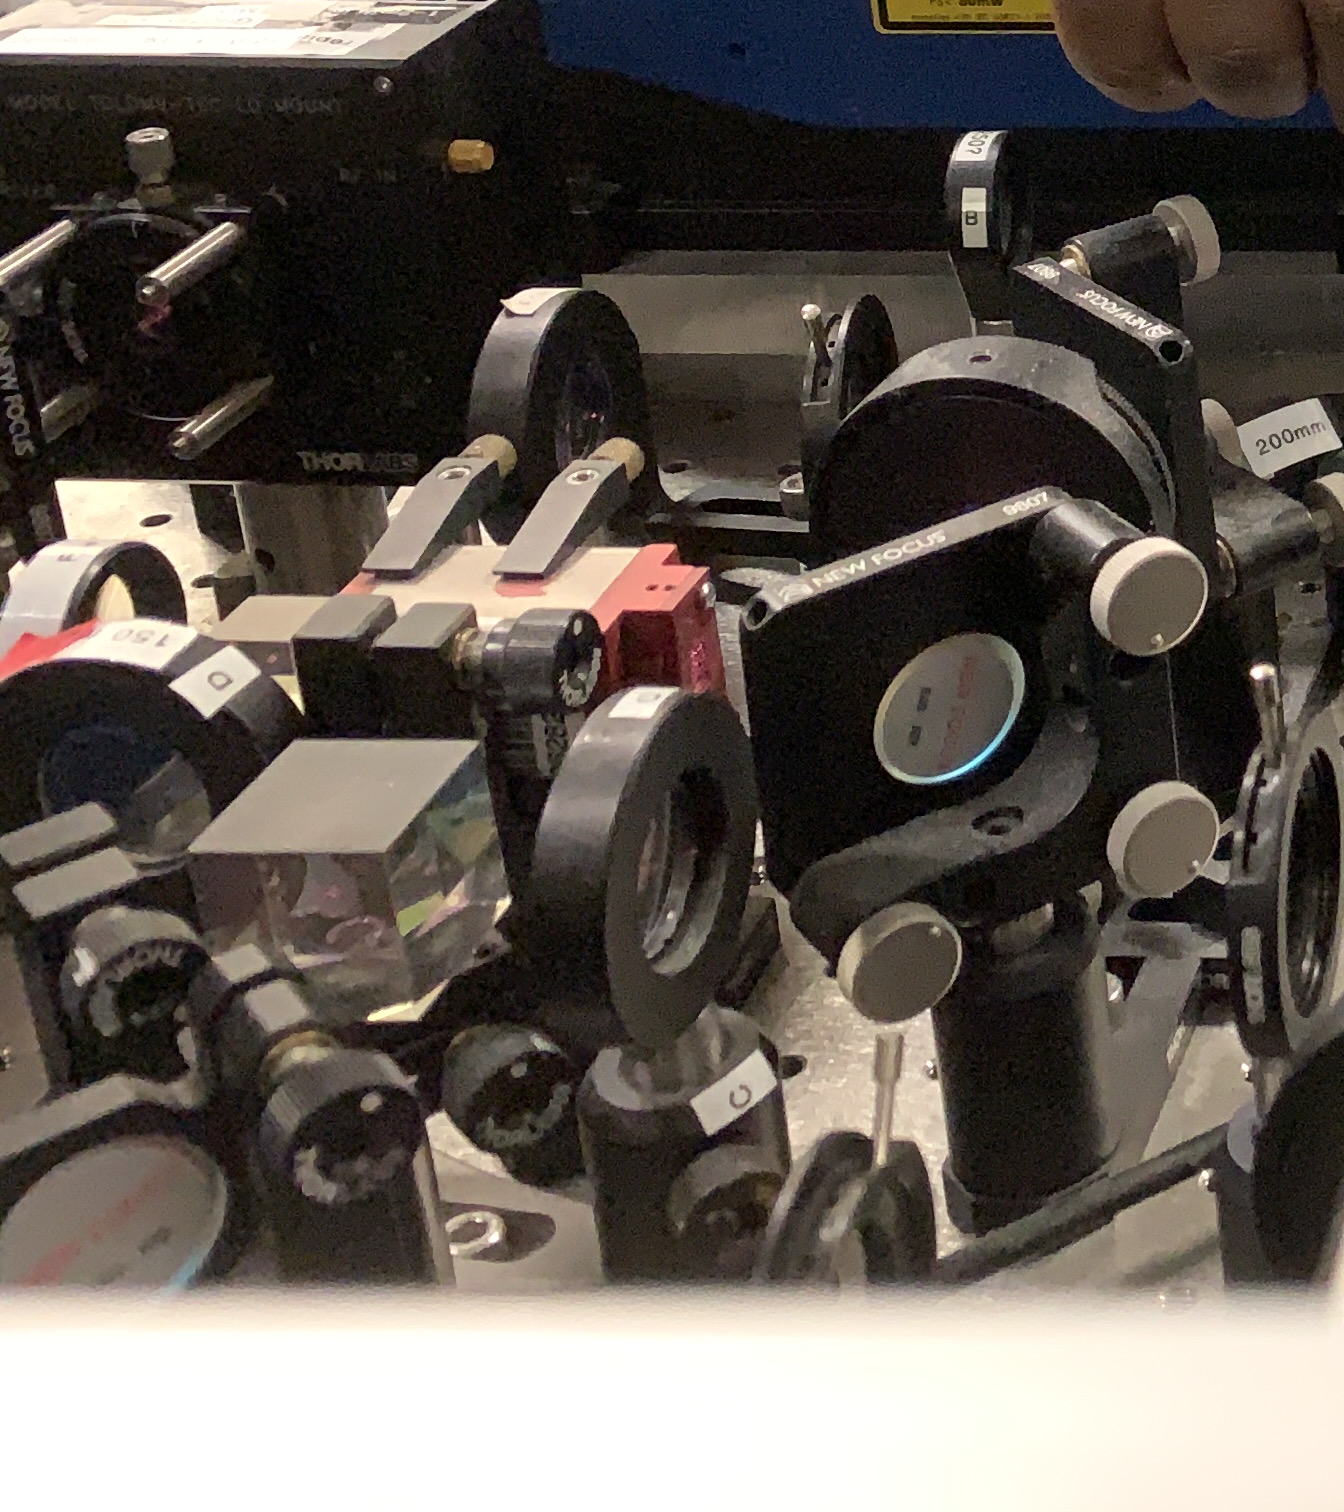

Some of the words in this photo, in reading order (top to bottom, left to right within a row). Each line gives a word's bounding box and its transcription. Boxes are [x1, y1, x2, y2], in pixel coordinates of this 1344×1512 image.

[1255, 421, 1327, 456] 200mm
[811, 558, 867, 589] NEW
[871, 529, 947, 565] FOCUS
